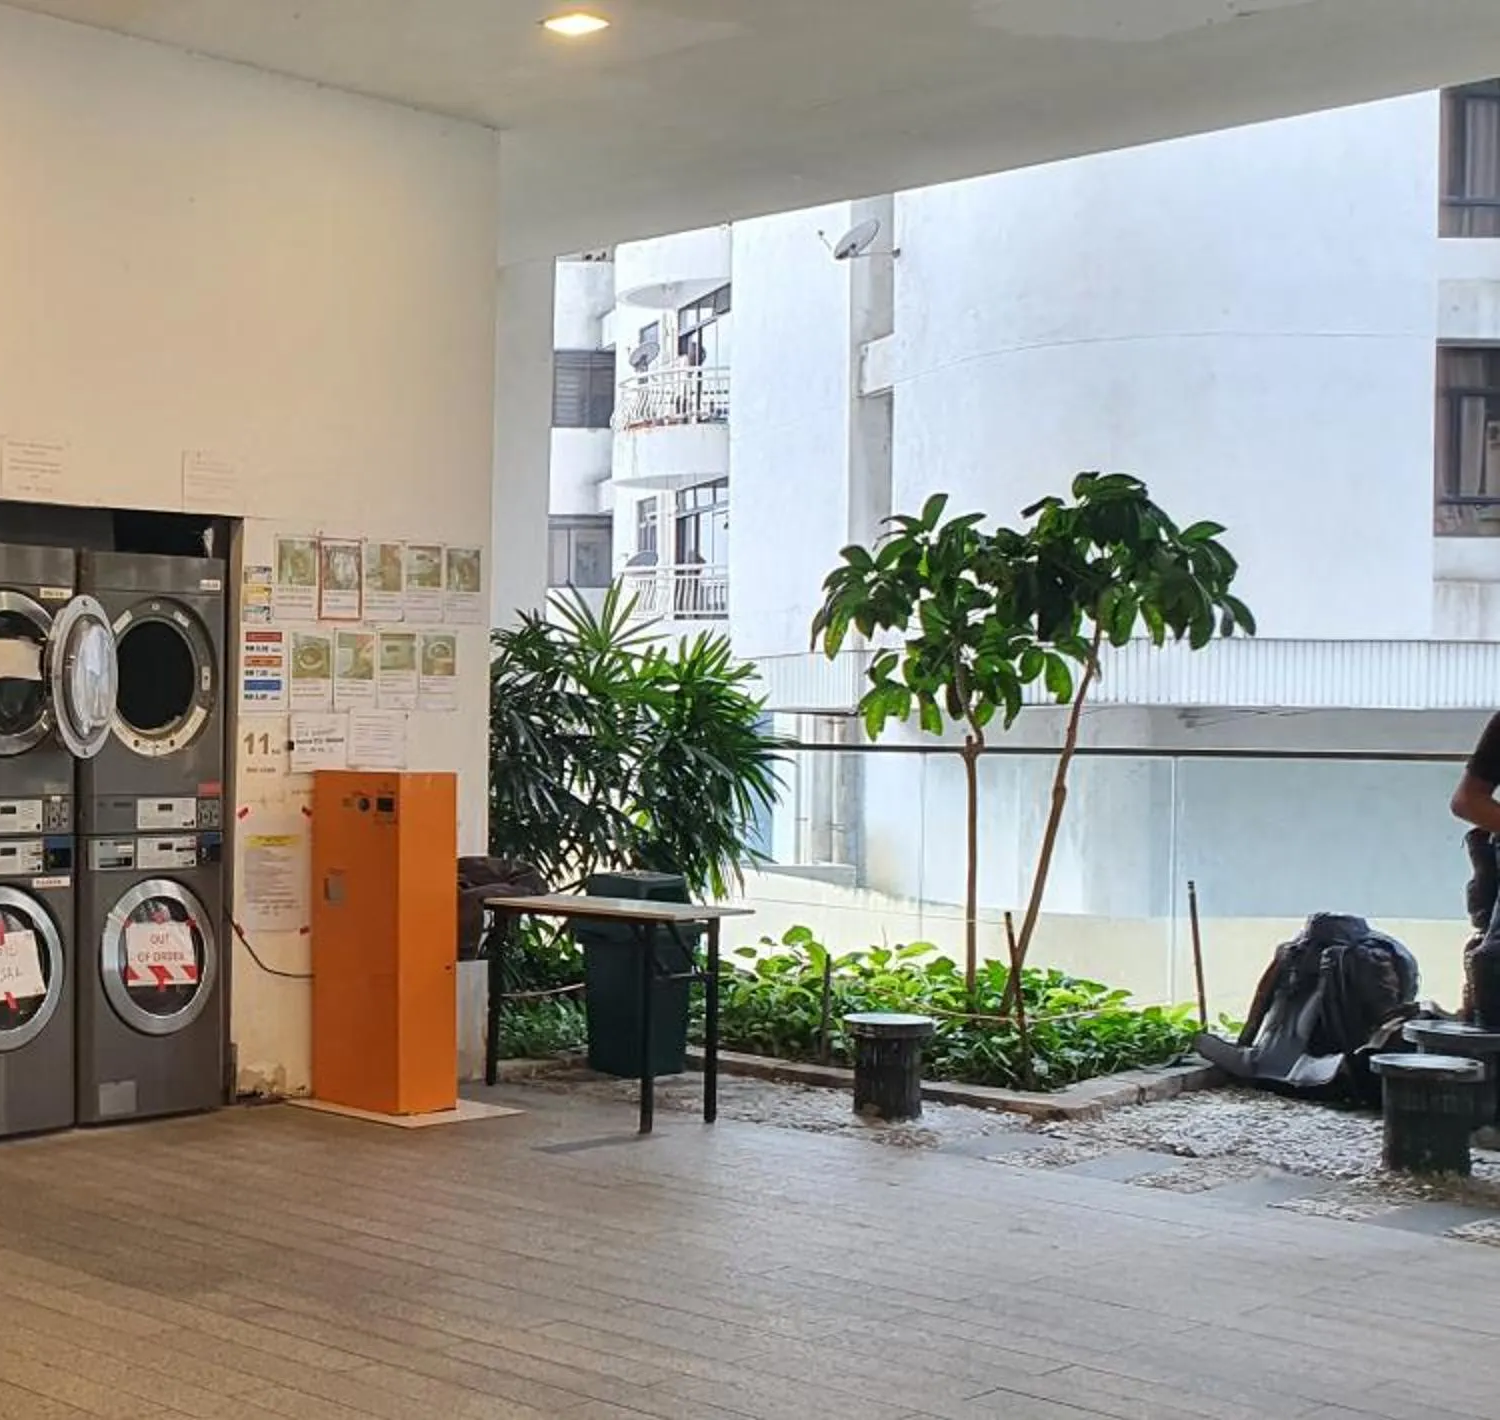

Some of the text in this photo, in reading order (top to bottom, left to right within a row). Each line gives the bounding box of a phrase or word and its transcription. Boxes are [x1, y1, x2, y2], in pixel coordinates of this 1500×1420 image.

[150, 932, 170, 945] OUT
[137, 951, 184, 962] OF ORDER
